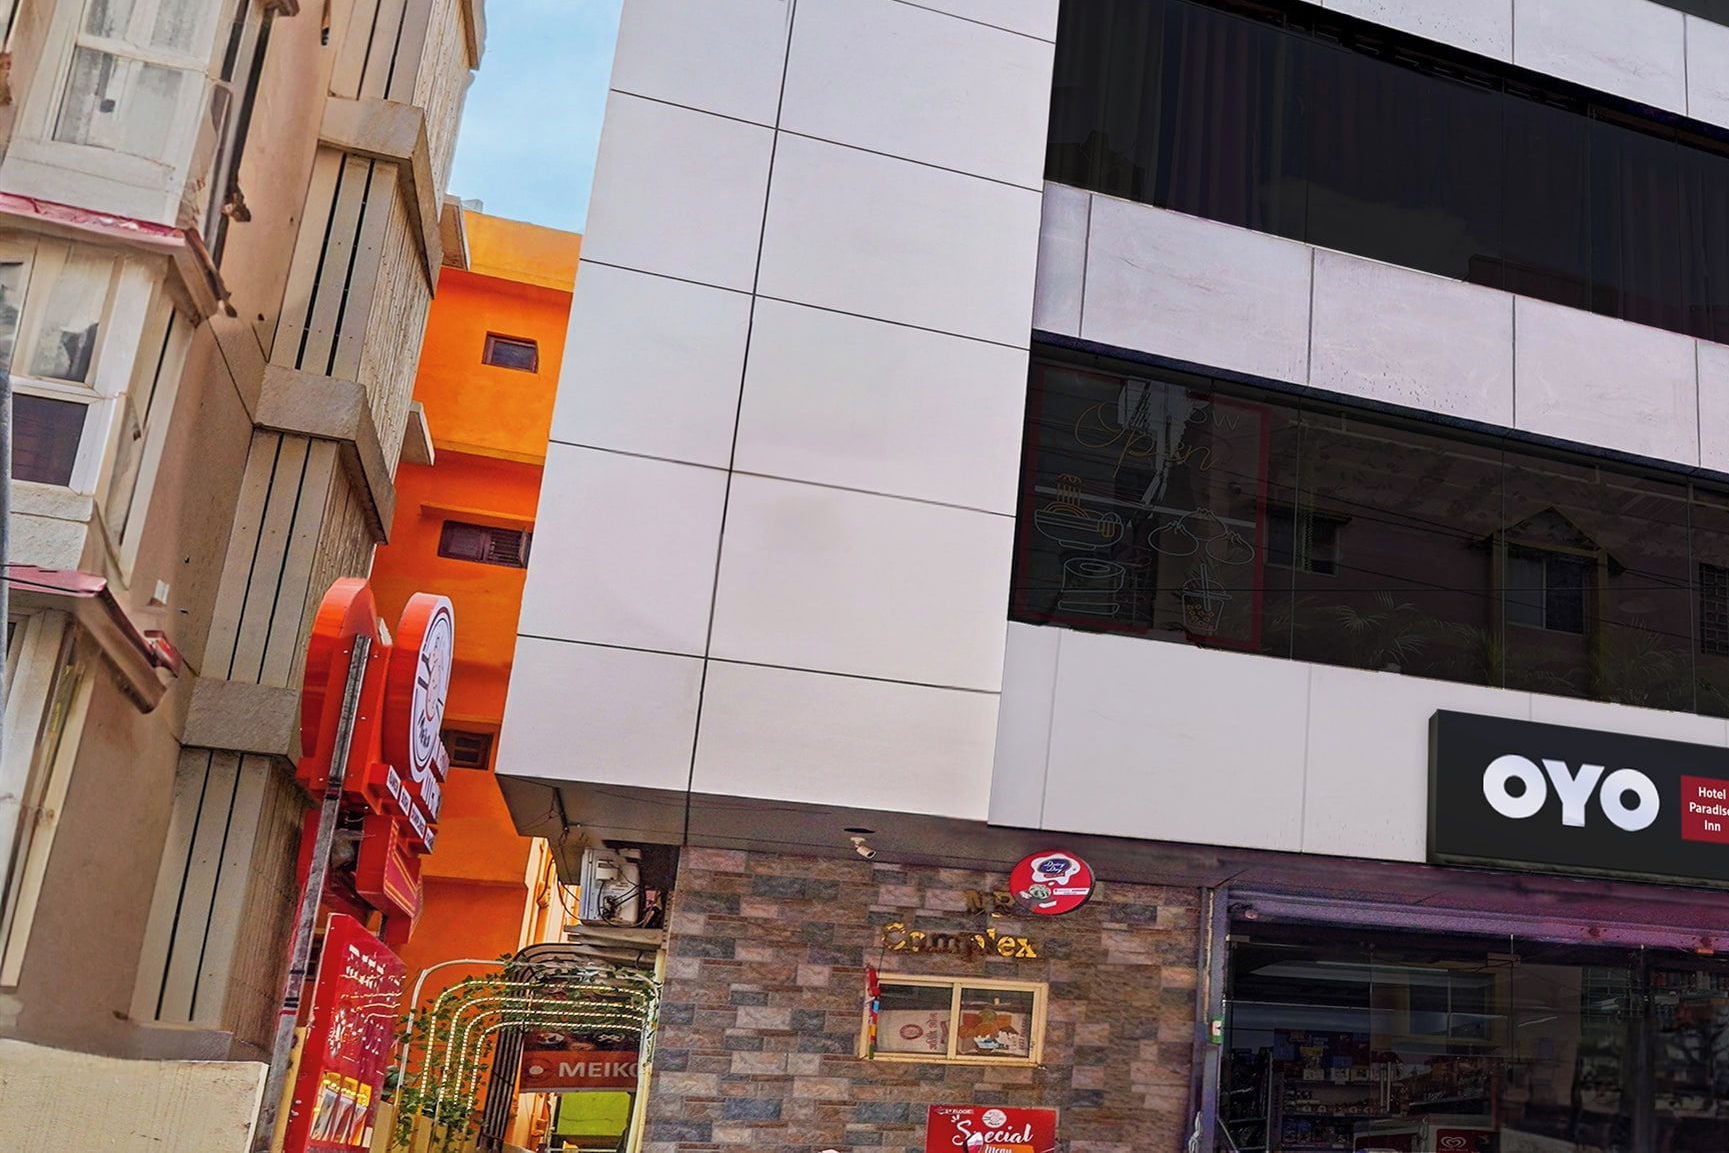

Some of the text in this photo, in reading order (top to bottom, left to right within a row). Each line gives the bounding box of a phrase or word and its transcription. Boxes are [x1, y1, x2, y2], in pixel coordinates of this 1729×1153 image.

[1483, 754, 1660, 831] OYO
[1698, 787, 1727, 800] Hotel
[1704, 819, 1722, 832] Inn
